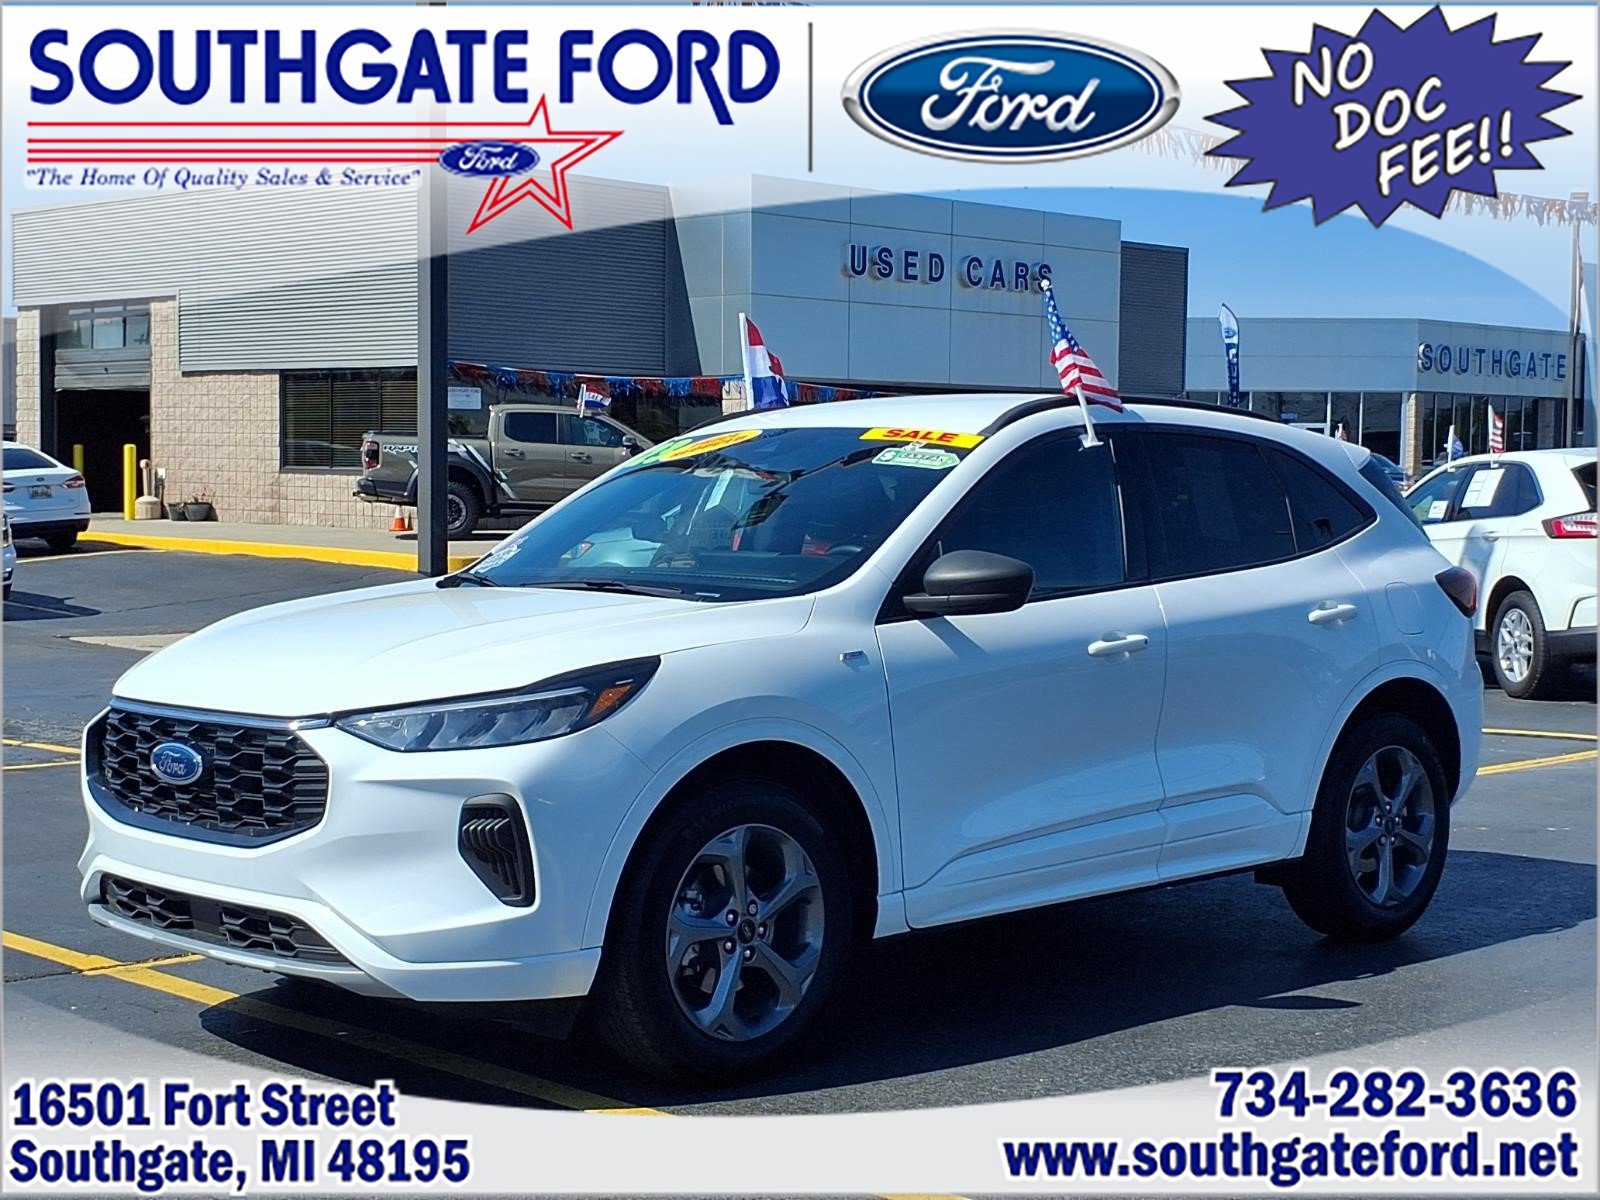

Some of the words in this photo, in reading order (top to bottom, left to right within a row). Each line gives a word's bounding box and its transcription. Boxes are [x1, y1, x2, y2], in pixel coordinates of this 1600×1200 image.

[849, 243, 946, 285] USED
[964, 255, 1054, 295] CARS
[1418, 342, 1567, 380] SOUTHGATE
[882, 428, 959, 443] SALE
[158, 750, 187, 776] Ford
